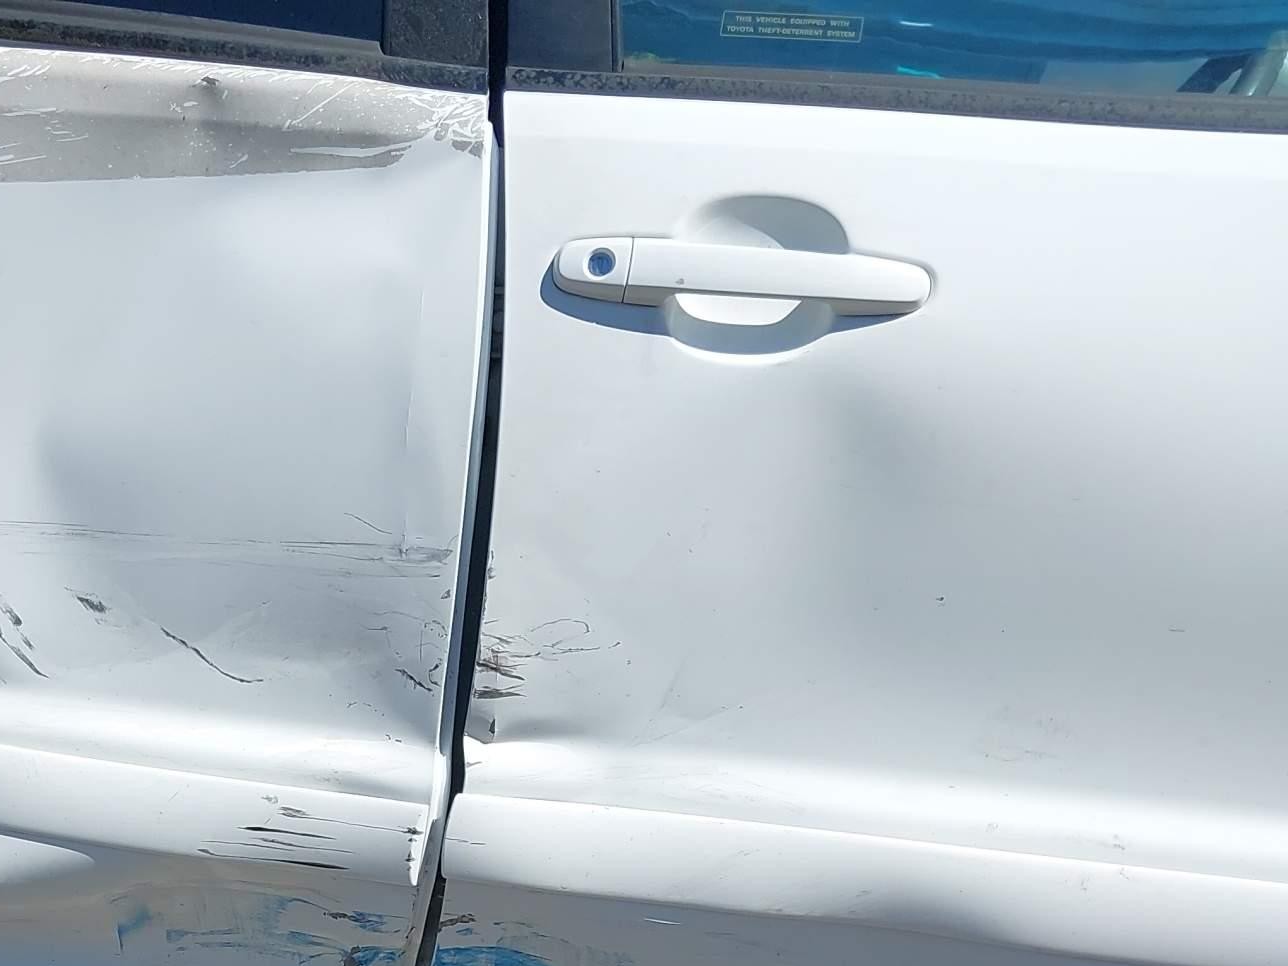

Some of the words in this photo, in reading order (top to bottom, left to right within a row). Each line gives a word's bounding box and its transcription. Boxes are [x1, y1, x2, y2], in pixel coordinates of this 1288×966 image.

[735, 15, 752, 23] THIS
[755, 16, 787, 24] VEHICLE
[790, 18, 826, 26] EQUIPPED
[758, 27, 824, 36] THEFT-DETERRENT
[826, 30, 856, 38] SYSTEM
